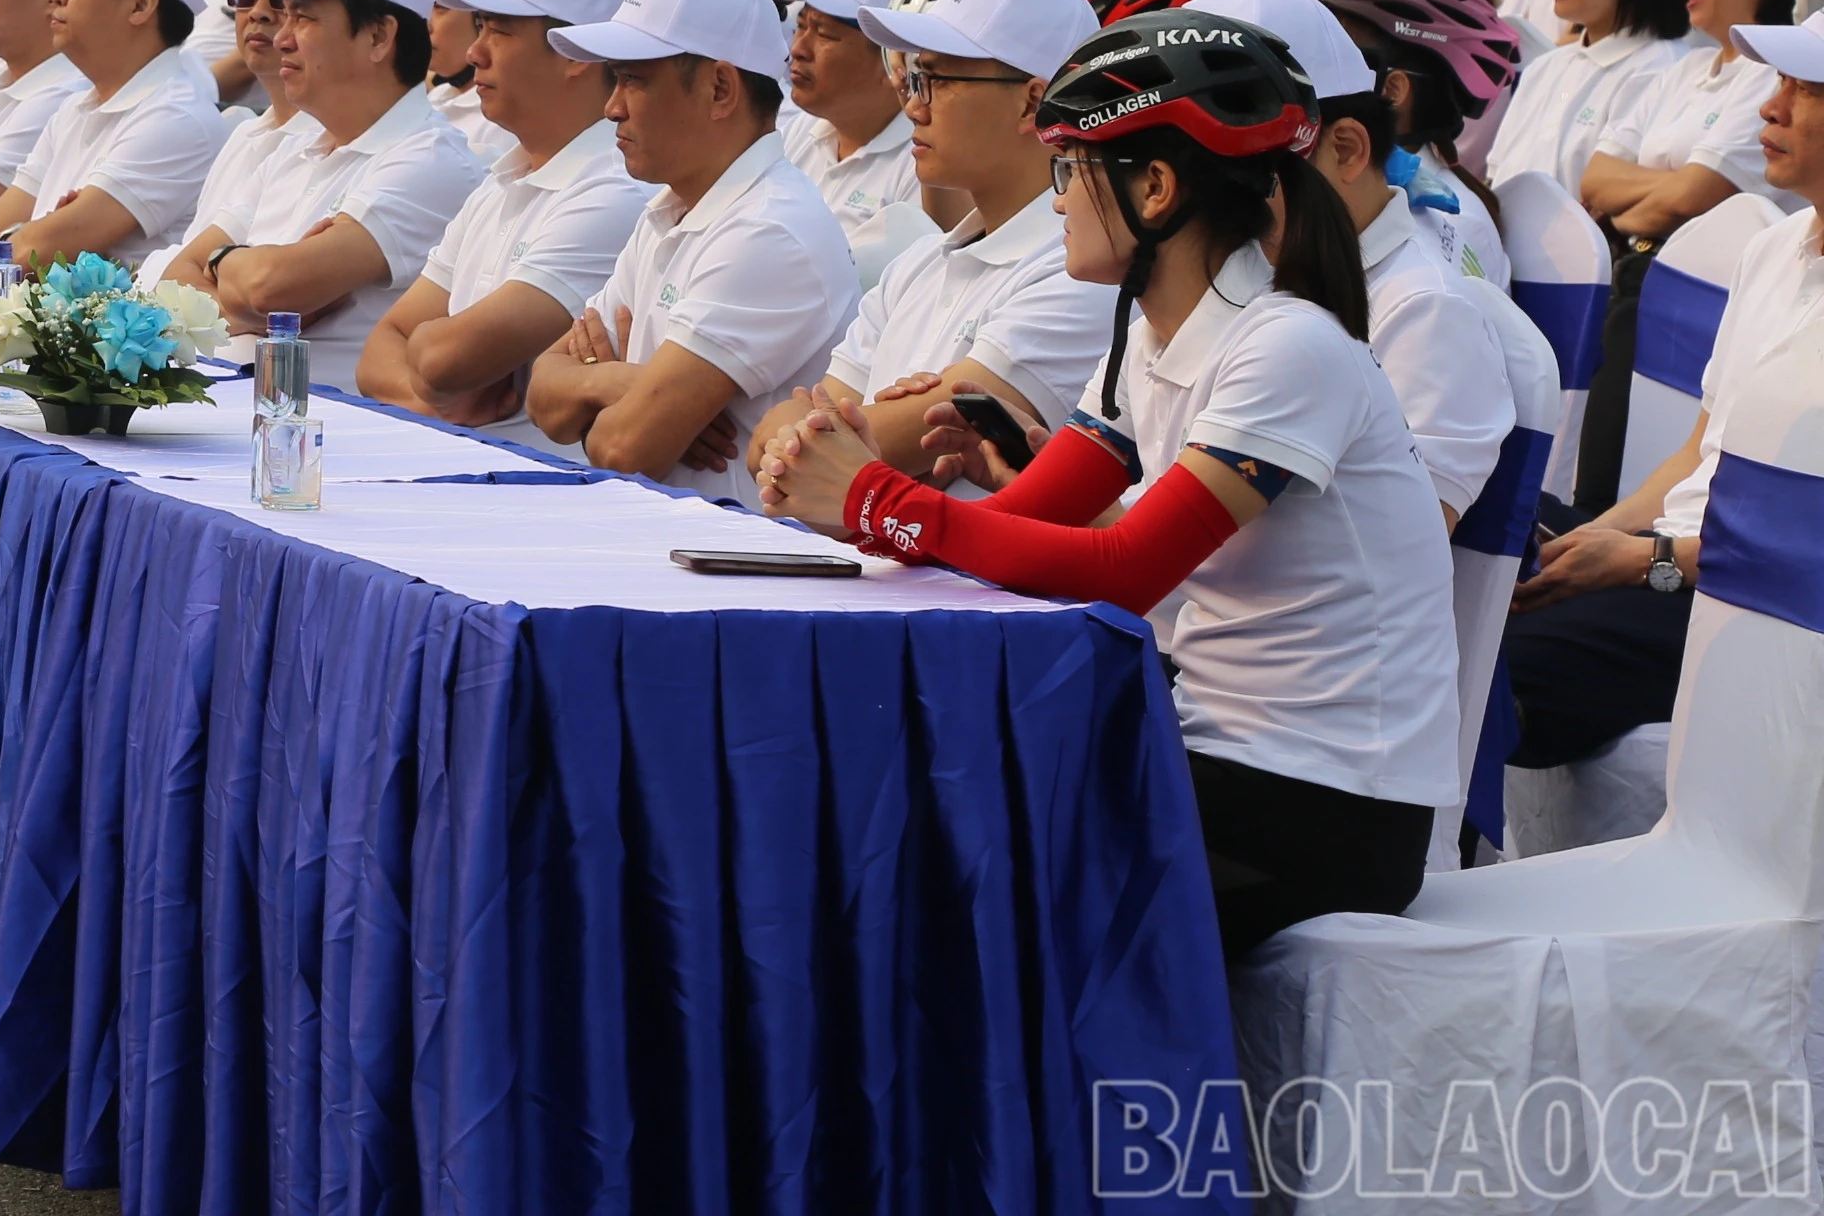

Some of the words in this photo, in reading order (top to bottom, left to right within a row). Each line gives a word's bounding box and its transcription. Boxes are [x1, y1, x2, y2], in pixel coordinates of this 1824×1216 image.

[1157, 29, 1244, 48] KASK
[1079, 91, 1161, 131] COLLAGEN
[860, 489, 875, 518] COOL
